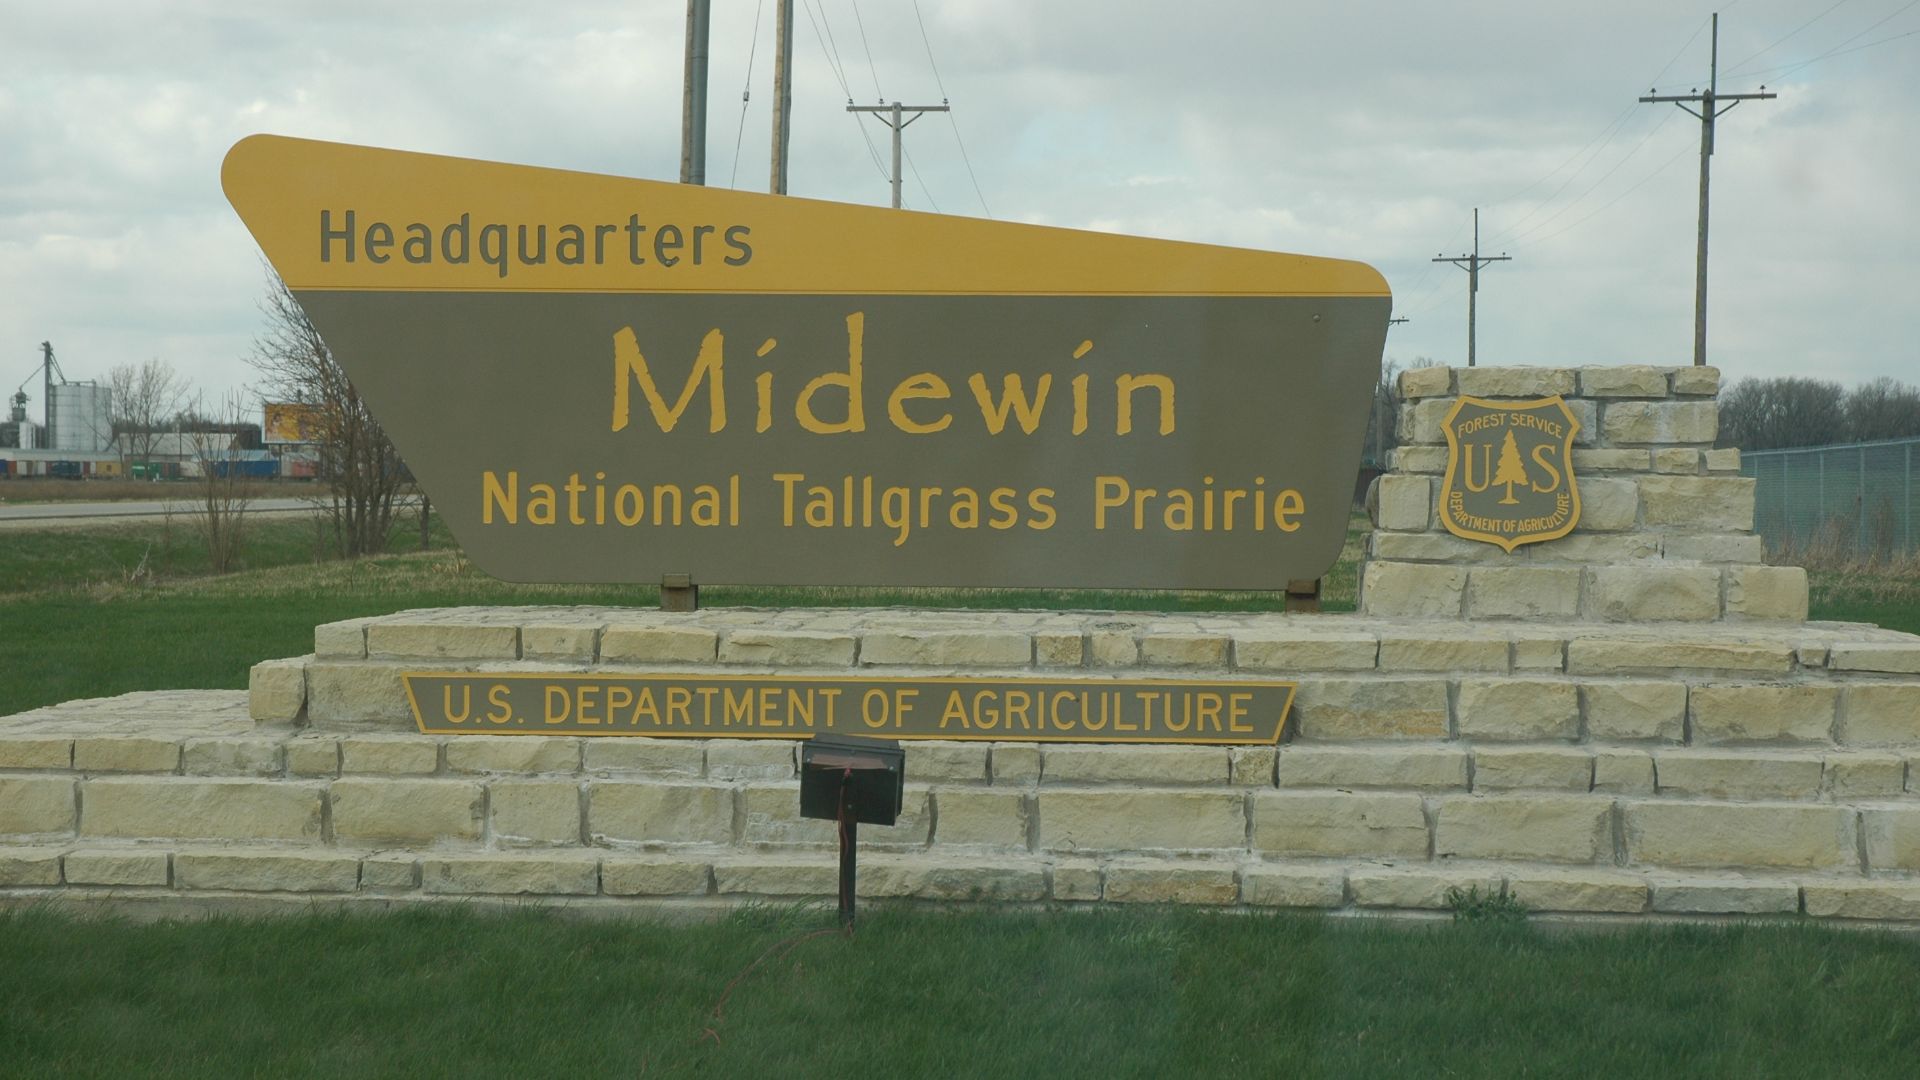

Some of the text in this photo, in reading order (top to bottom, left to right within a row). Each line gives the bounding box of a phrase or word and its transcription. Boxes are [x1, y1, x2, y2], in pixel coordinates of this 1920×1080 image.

[320, 209, 753, 278] Headquarters
[610, 311, 1176, 436] Midewin
[1457, 413, 1562, 439] FOREST SERVICE
[482, 470, 1305, 546] National Tallgrass Prairie
[1450, 491, 1570, 533] DEPARTMENT OF AGRICULTURE
[443, 684, 1255, 732] U.S. DEPARTMENT OF AGRICULTURE
